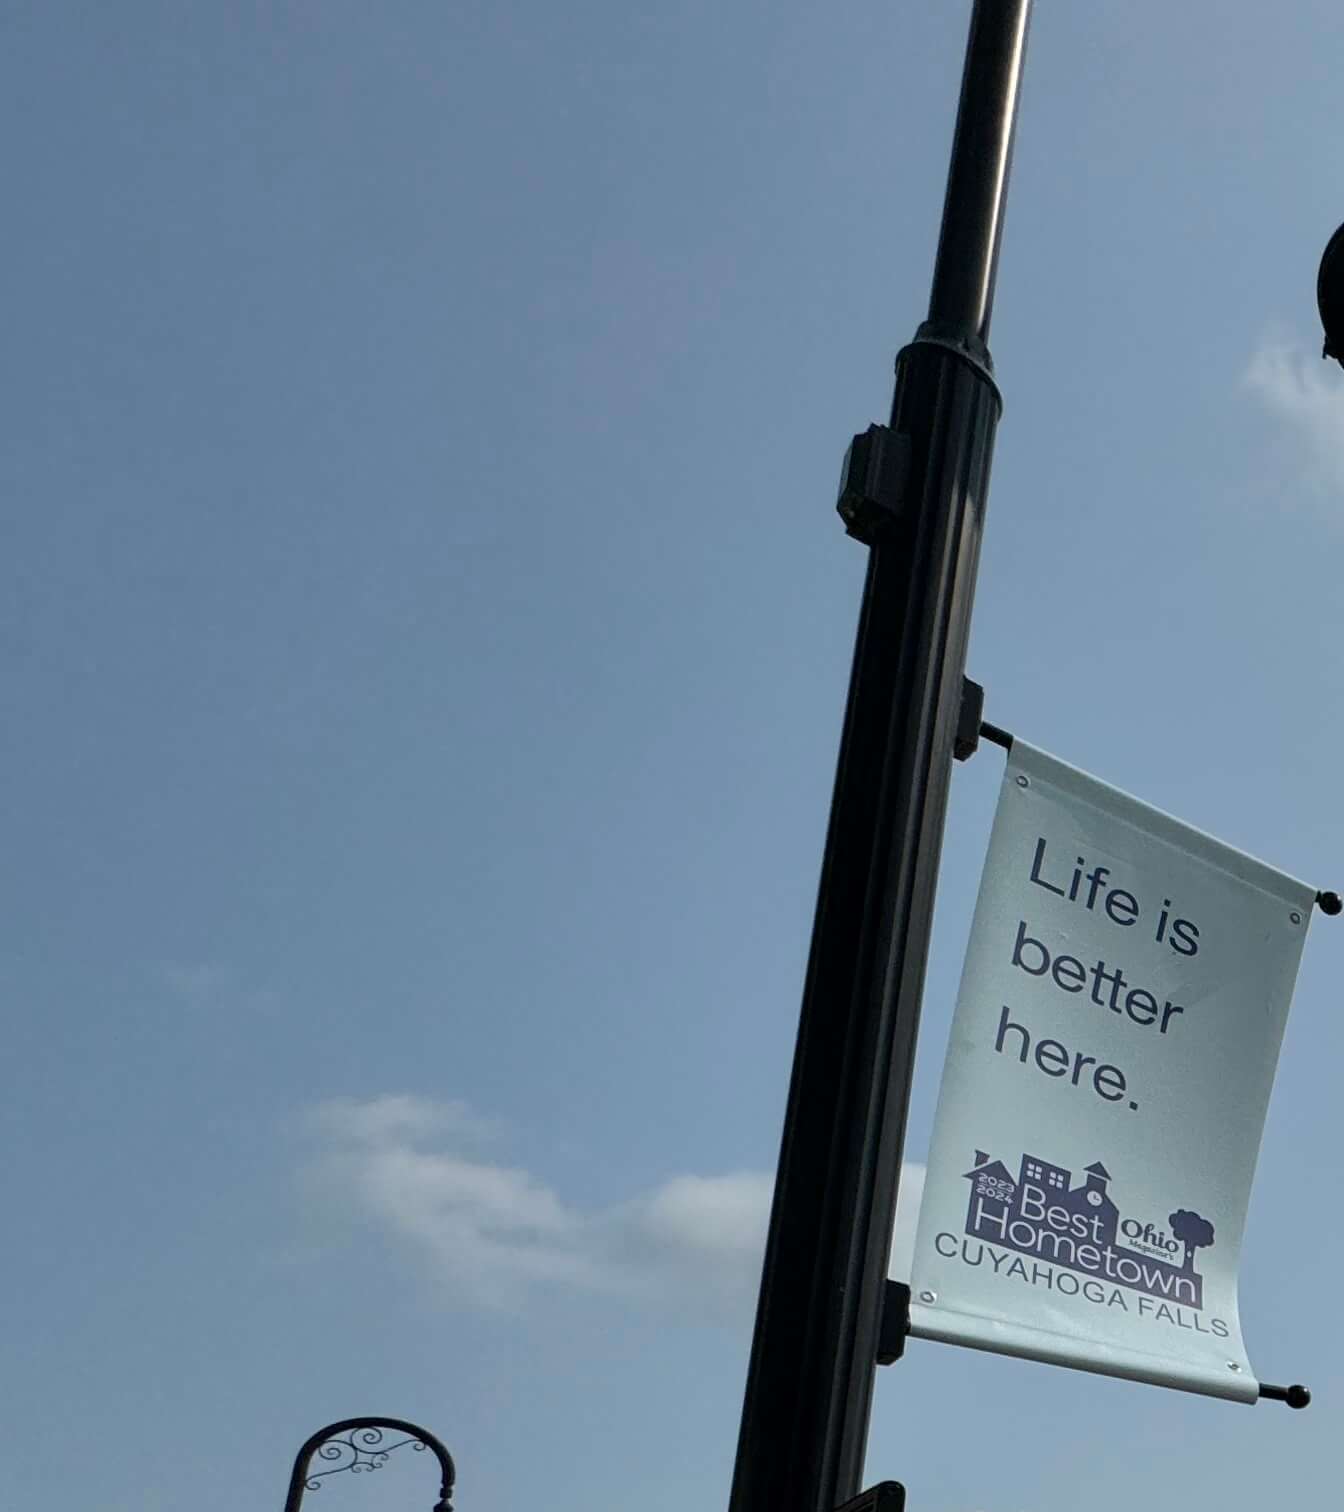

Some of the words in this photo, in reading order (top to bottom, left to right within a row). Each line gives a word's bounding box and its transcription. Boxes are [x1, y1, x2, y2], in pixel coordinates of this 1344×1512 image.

[1029, 838, 1138, 927] Life
[1155, 899, 1201, 957] is
[1011, 922, 1185, 1034] better
[995, 1006, 1139, 1111] here.
[976, 1184, 1014, 1204] 2024
[978, 1172, 1015, 1193] 2023
[1020, 1183, 1104, 1244] Best
[935, 1232, 1128, 1312] CUYAHOGA
[1138, 1296, 1230, 1338] FALLS
[974, 1197, 1196, 1303] Hometown
[1121, 1218, 1179, 1253] Ohio
